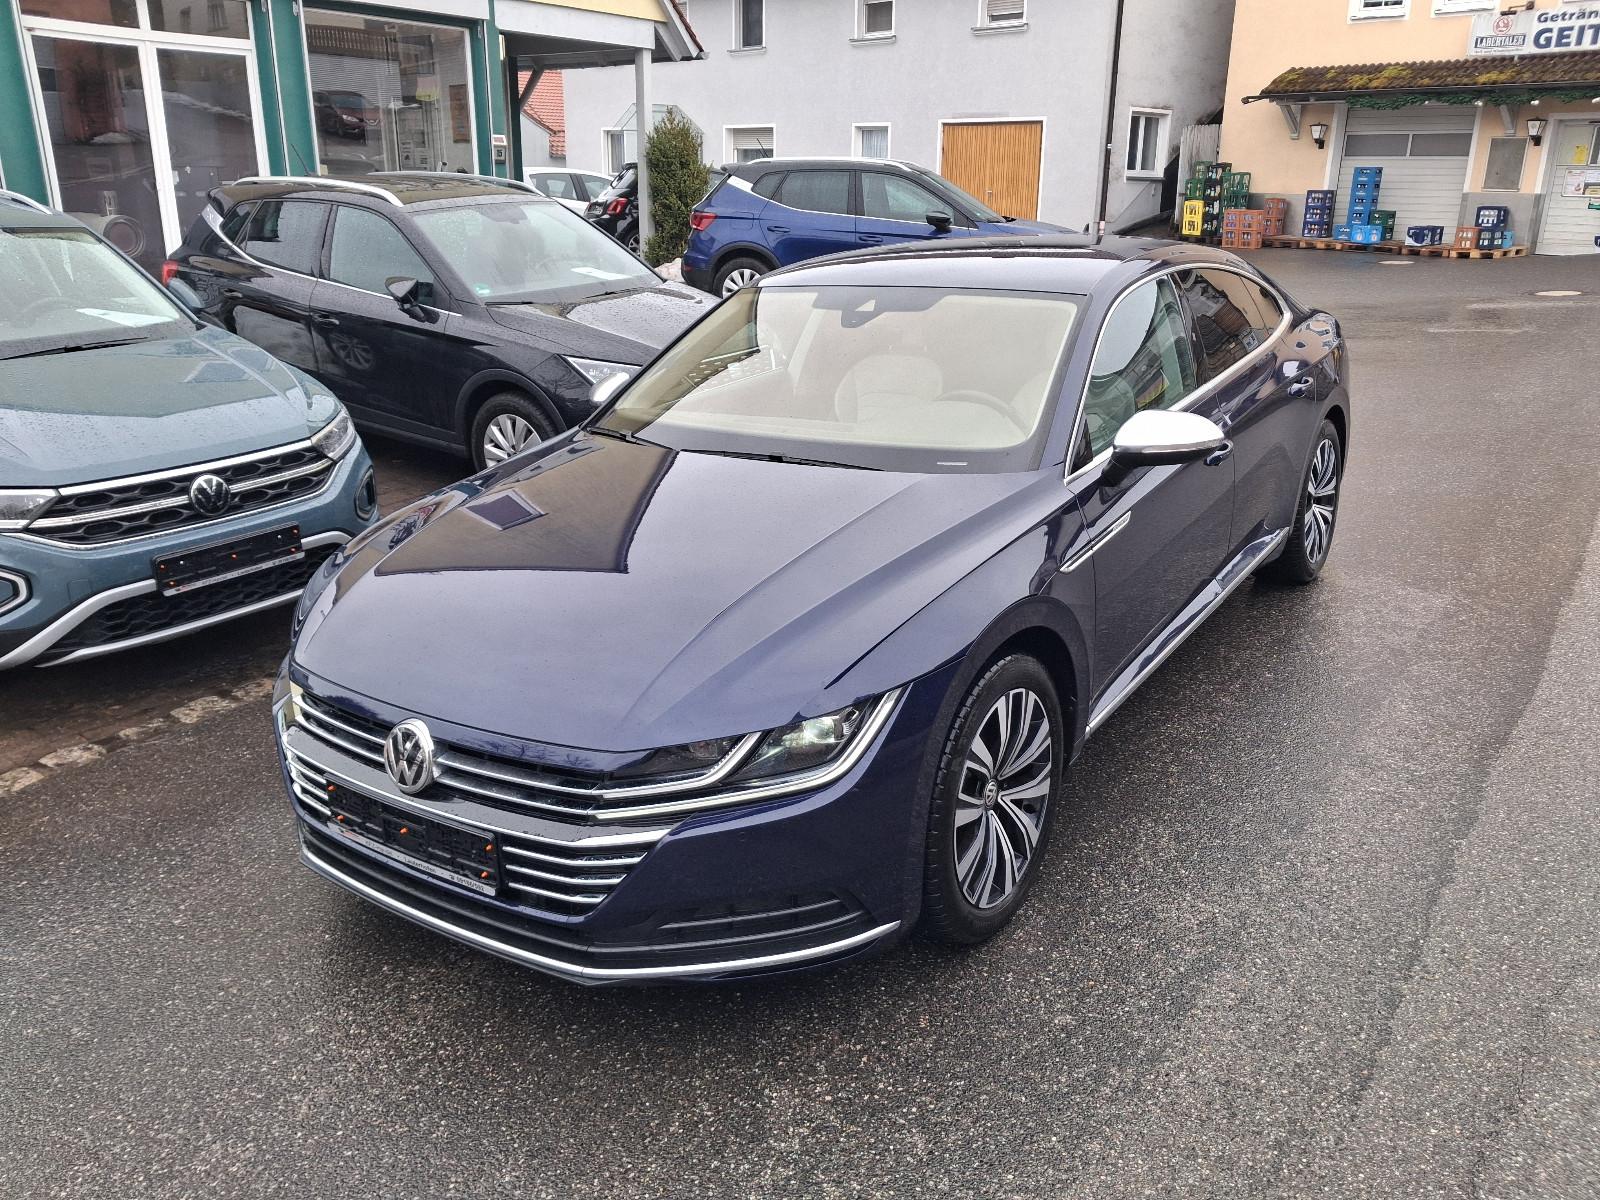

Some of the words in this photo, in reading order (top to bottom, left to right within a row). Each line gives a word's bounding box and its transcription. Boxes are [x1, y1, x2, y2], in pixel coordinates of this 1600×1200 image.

[1537, 8, 1599, 23] Geträn
[1476, 34, 1525, 48] LABERTALER
[1533, 24, 1600, 49] GEIT
